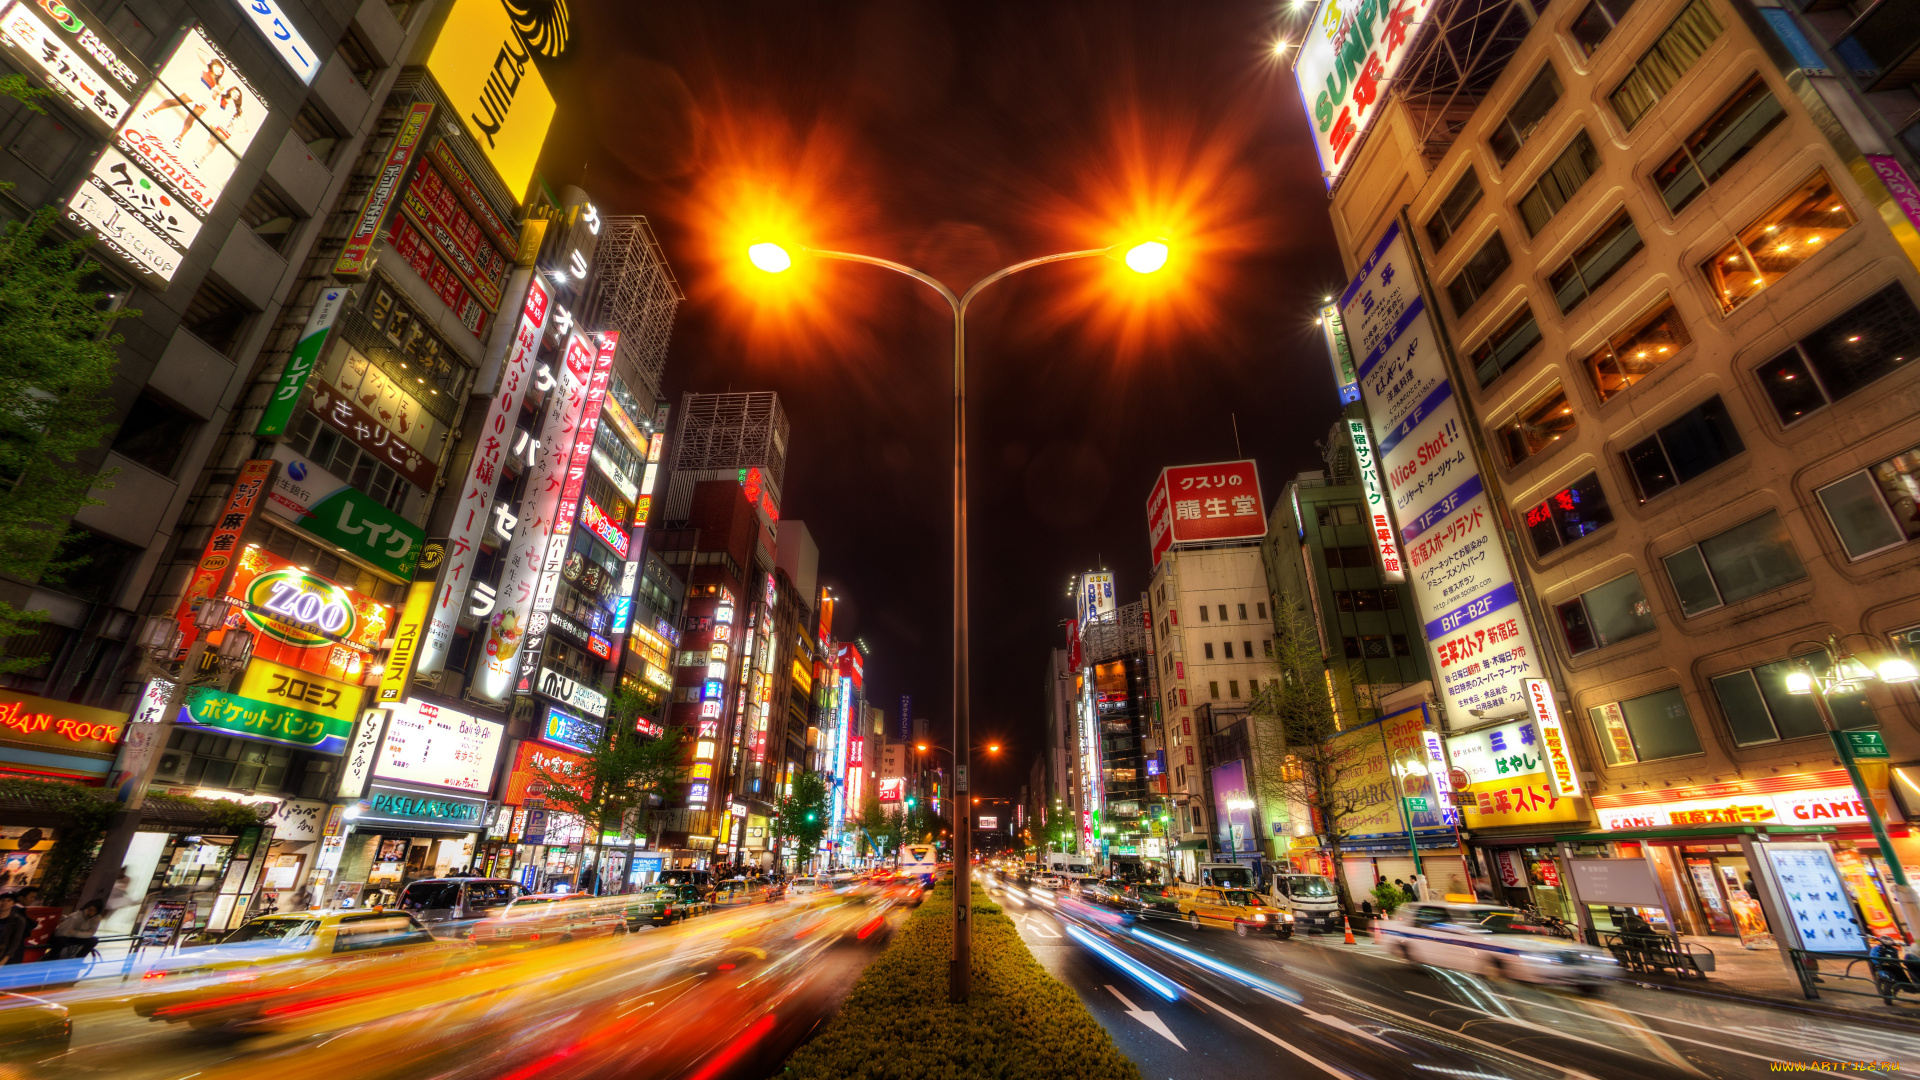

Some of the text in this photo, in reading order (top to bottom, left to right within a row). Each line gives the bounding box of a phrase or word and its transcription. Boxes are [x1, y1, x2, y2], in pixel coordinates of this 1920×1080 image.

[76, 35, 124, 82] DINING
[82, 25, 139, 84] PARTNERS
[117, 138, 206, 218] 9F バドワイザーカーニバル
[124, 128, 214, 209] Carnival
[91, 176, 181, 249] 8F アジア de クッション
[109, 162, 186, 234] クッション
[433, 224, 477, 277] インターネット
[1359, 252, 1378, 282] 6F
[1361, 262, 1396, 316] 三平
[1379, 325, 1398, 354] 5F
[278, 356, 310, 401] レイク
[1366, 359, 1388, 388] レストラン
[1375, 337, 1418, 396] はやしや
[1386, 370, 1415, 404] 洋風料理
[332, 401, 407, 464] きゃりこ
[1401, 408, 1424, 435] 4F
[1179, 474, 1243, 490] クスリの
[1389, 456, 1417, 490] Nice
[271, 493, 308, 516] カードローン
[1175, 494, 1258, 521] 龍生堂
[1350, 422, 1400, 572] 新宿サンパーク 三平本館
[212, 512, 246, 552] 麻雀
[336, 500, 414, 559] レイク
[597, 515, 628, 559] ウェルカム
[1410, 505, 1484, 568] 新宿スポーツランド
[202, 557, 227, 568] ZOO
[397, 563, 410, 575] 4F
[1419, 534, 1489, 581] インターネットでお馴染みの
[1426, 550, 1486, 591] アミューズメントパーク
[1442, 574, 1476, 598] 新宿スポラン
[263, 580, 348, 633] ZOO
[268, 620, 293, 635] SINCE
[340, 637, 372, 653] MAHJONG
[1436, 618, 1520, 668] 三平ストア 新宿店
[387, 623, 419, 682] プロミス
[266, 672, 343, 710] プロミス
[383, 689, 397, 698] 2F
[1447, 661, 1530, 698] 毎日特売のスーパーマーケット
[199, 697, 325, 739] ポケットバンク
[1531, 682, 1549, 723] GAME
[56, 719, 119, 743] ROCK
[1851, 734, 1877, 744] モア
[1367, 755, 1384, 775] 389
[1543, 727, 1575, 794] 新宿スポラン
[375, 794, 427, 816] PASELA
[431, 801, 481, 823] RESORTS
[533, 810, 544, 825] P
[1477, 784, 1560, 816] 三平ストア
[1669, 804, 1775, 825] 新宿スポラン
[1793, 798, 1867, 820] GAME
[1609, 816, 1655, 830] GAME
